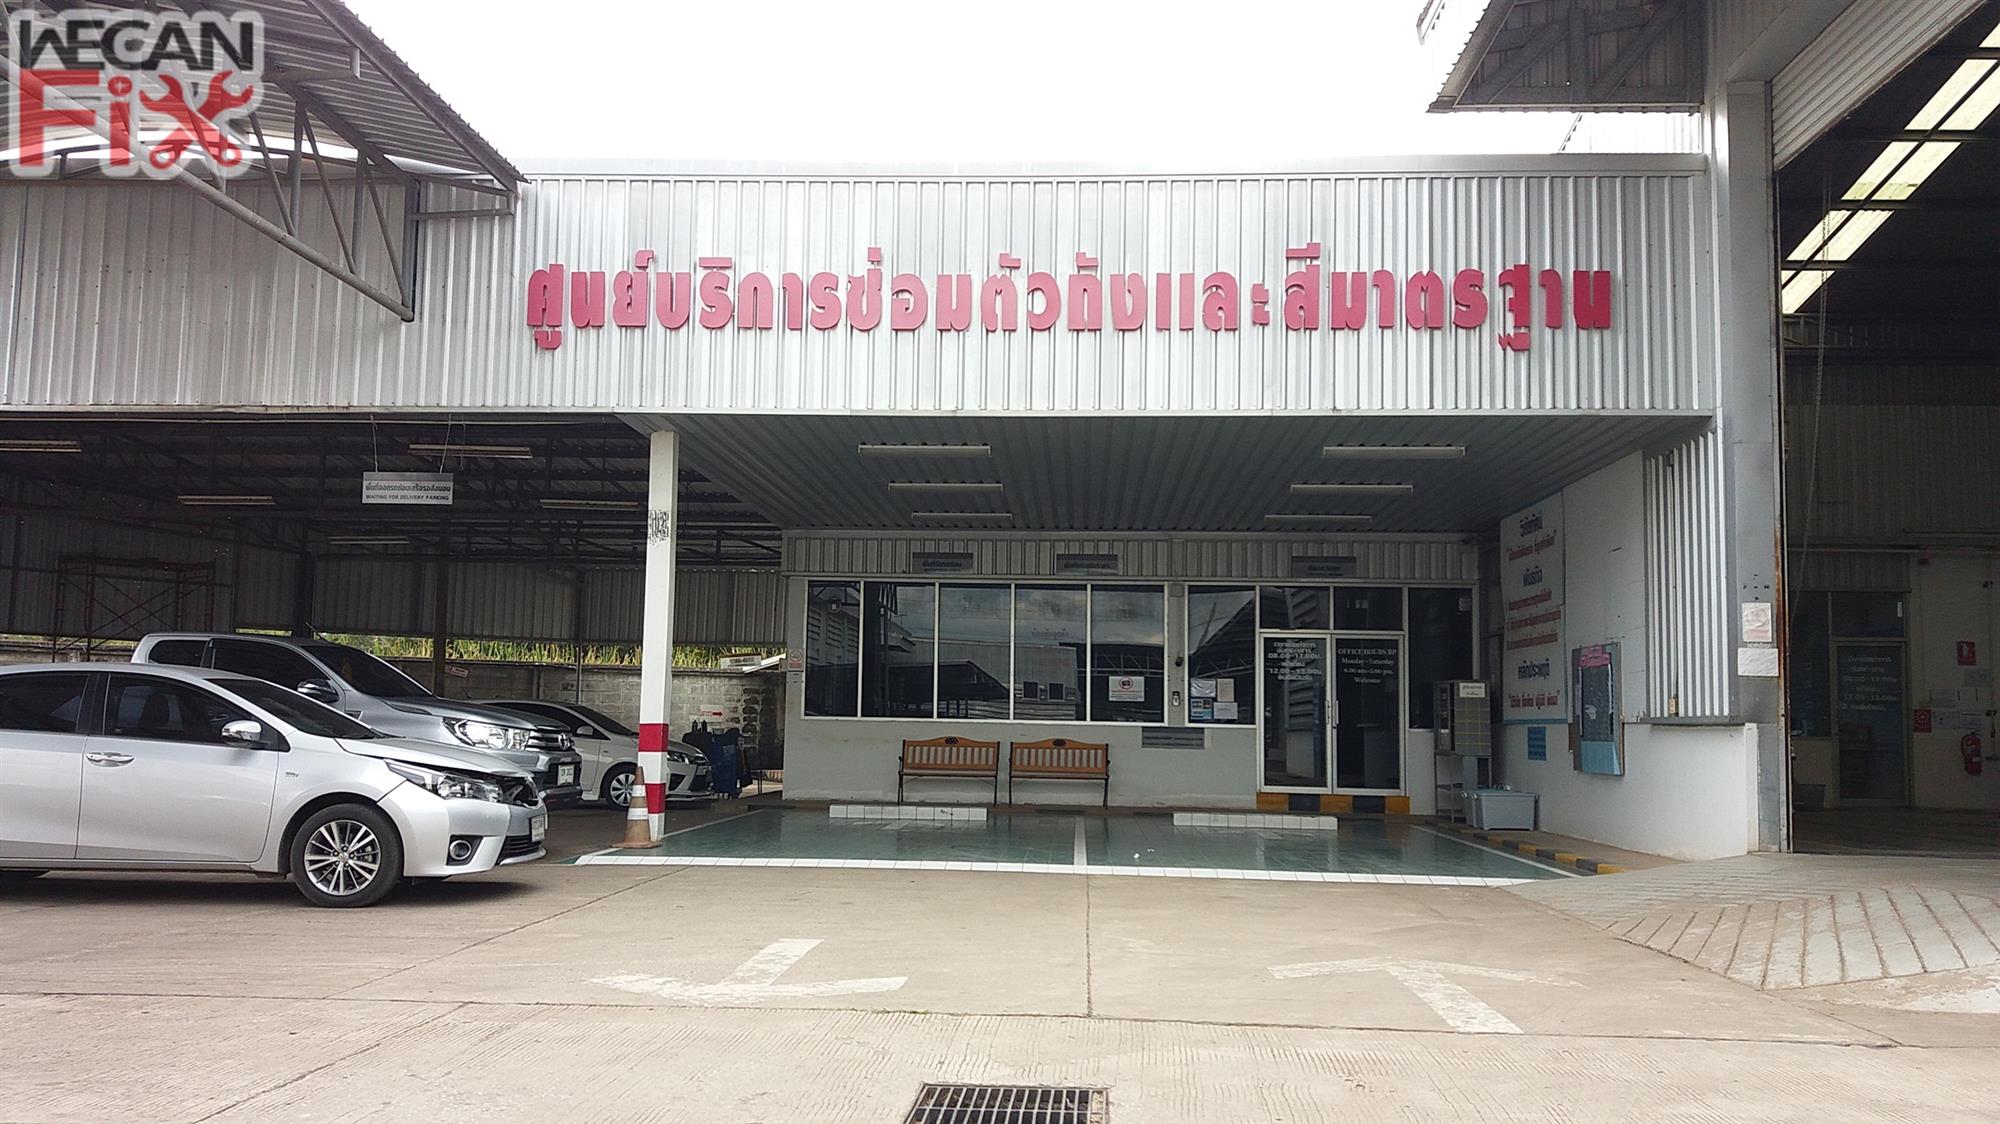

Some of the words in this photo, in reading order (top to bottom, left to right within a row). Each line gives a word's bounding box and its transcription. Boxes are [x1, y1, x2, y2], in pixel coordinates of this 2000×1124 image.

[527, 242, 1612, 352] ศูนย์บริการซ่อมตัวถังและสีมาตรฐาน
